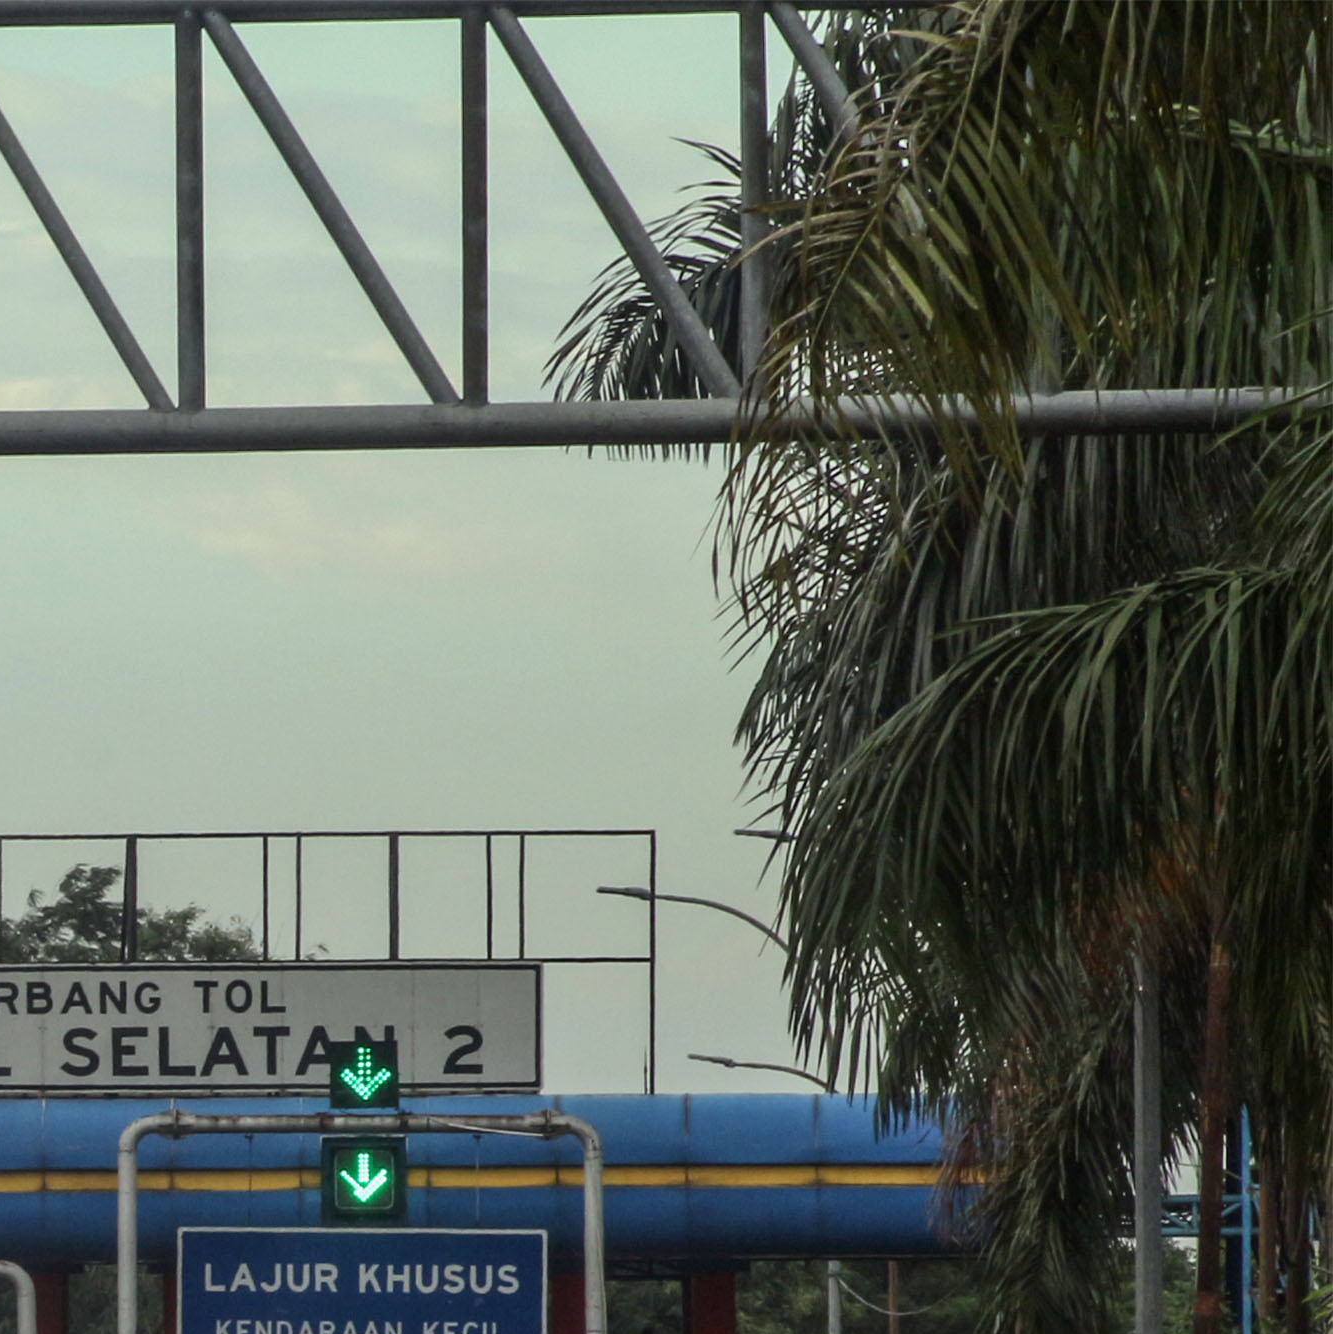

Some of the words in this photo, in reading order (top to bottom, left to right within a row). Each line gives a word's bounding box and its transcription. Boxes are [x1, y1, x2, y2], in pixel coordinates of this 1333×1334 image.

[201, 979, 288, 1015] TOL
[442, 1025, 485, 1076] 2
[204, 1262, 339, 1293] LAJUR
[358, 1263, 520, 1294] KHUSUS
